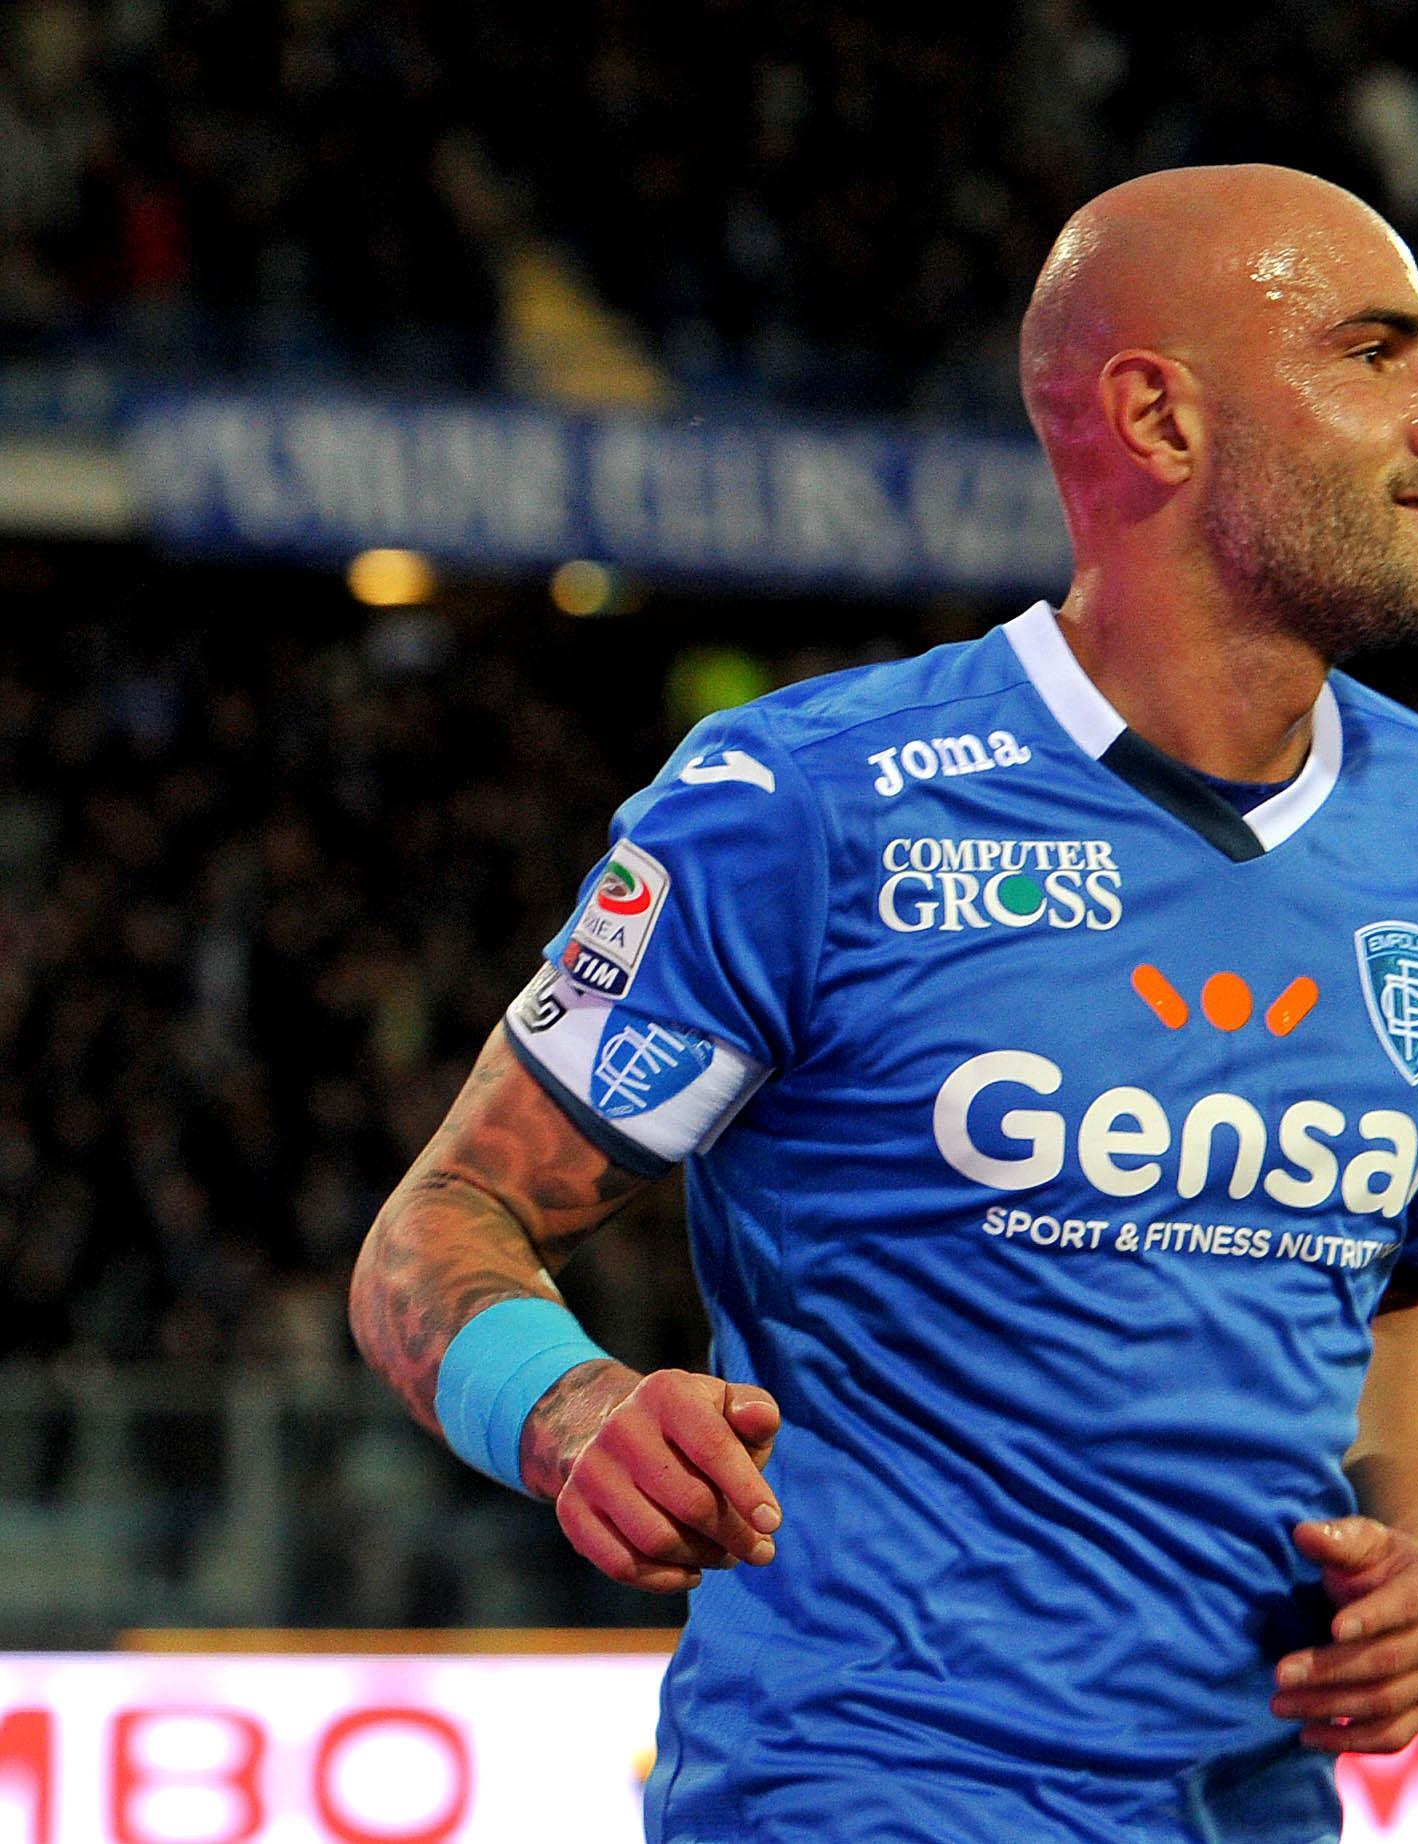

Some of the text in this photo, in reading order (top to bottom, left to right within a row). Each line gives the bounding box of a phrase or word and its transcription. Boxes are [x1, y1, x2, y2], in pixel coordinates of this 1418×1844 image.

[867, 730, 1032, 798] Joma
[882, 838, 1119, 872] COMPUTER
[878, 869, 1123, 933] GROSS
[573, 951, 620, 990] TIM
[981, 1206, 1402, 1270] SPORT & FITNESS NUTRIT
